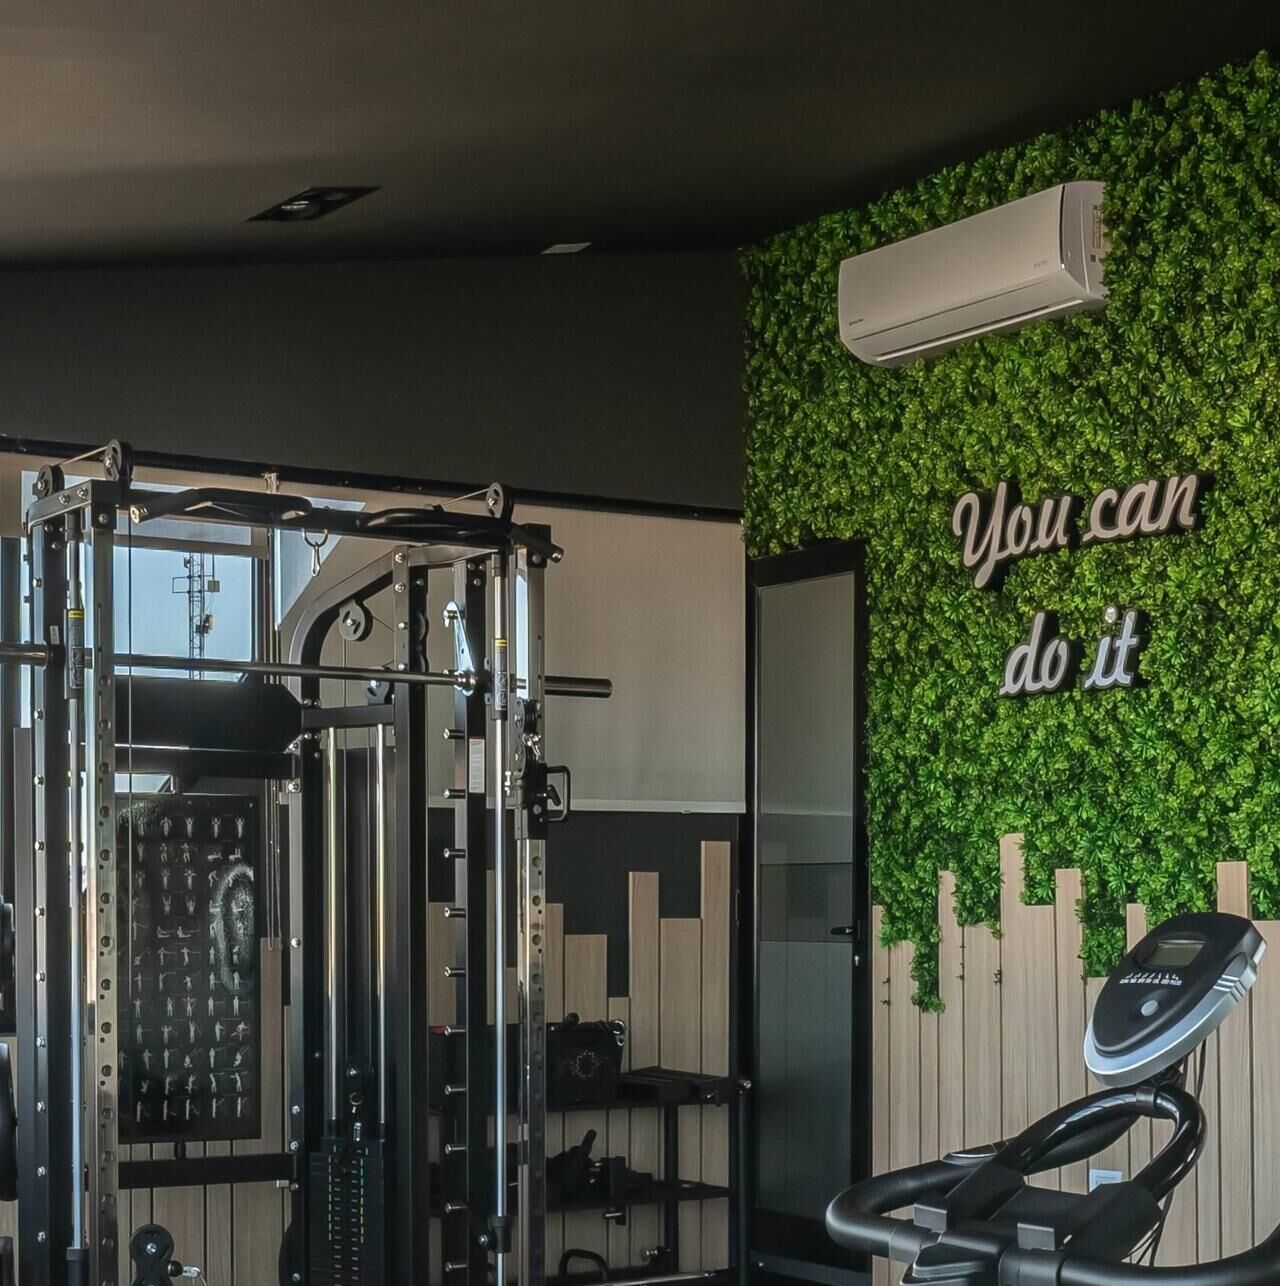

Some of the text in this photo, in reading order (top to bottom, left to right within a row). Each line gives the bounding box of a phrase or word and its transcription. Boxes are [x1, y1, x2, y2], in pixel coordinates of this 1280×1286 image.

[951, 473, 1199, 589] You can
[998, 605, 1139, 696] do it
